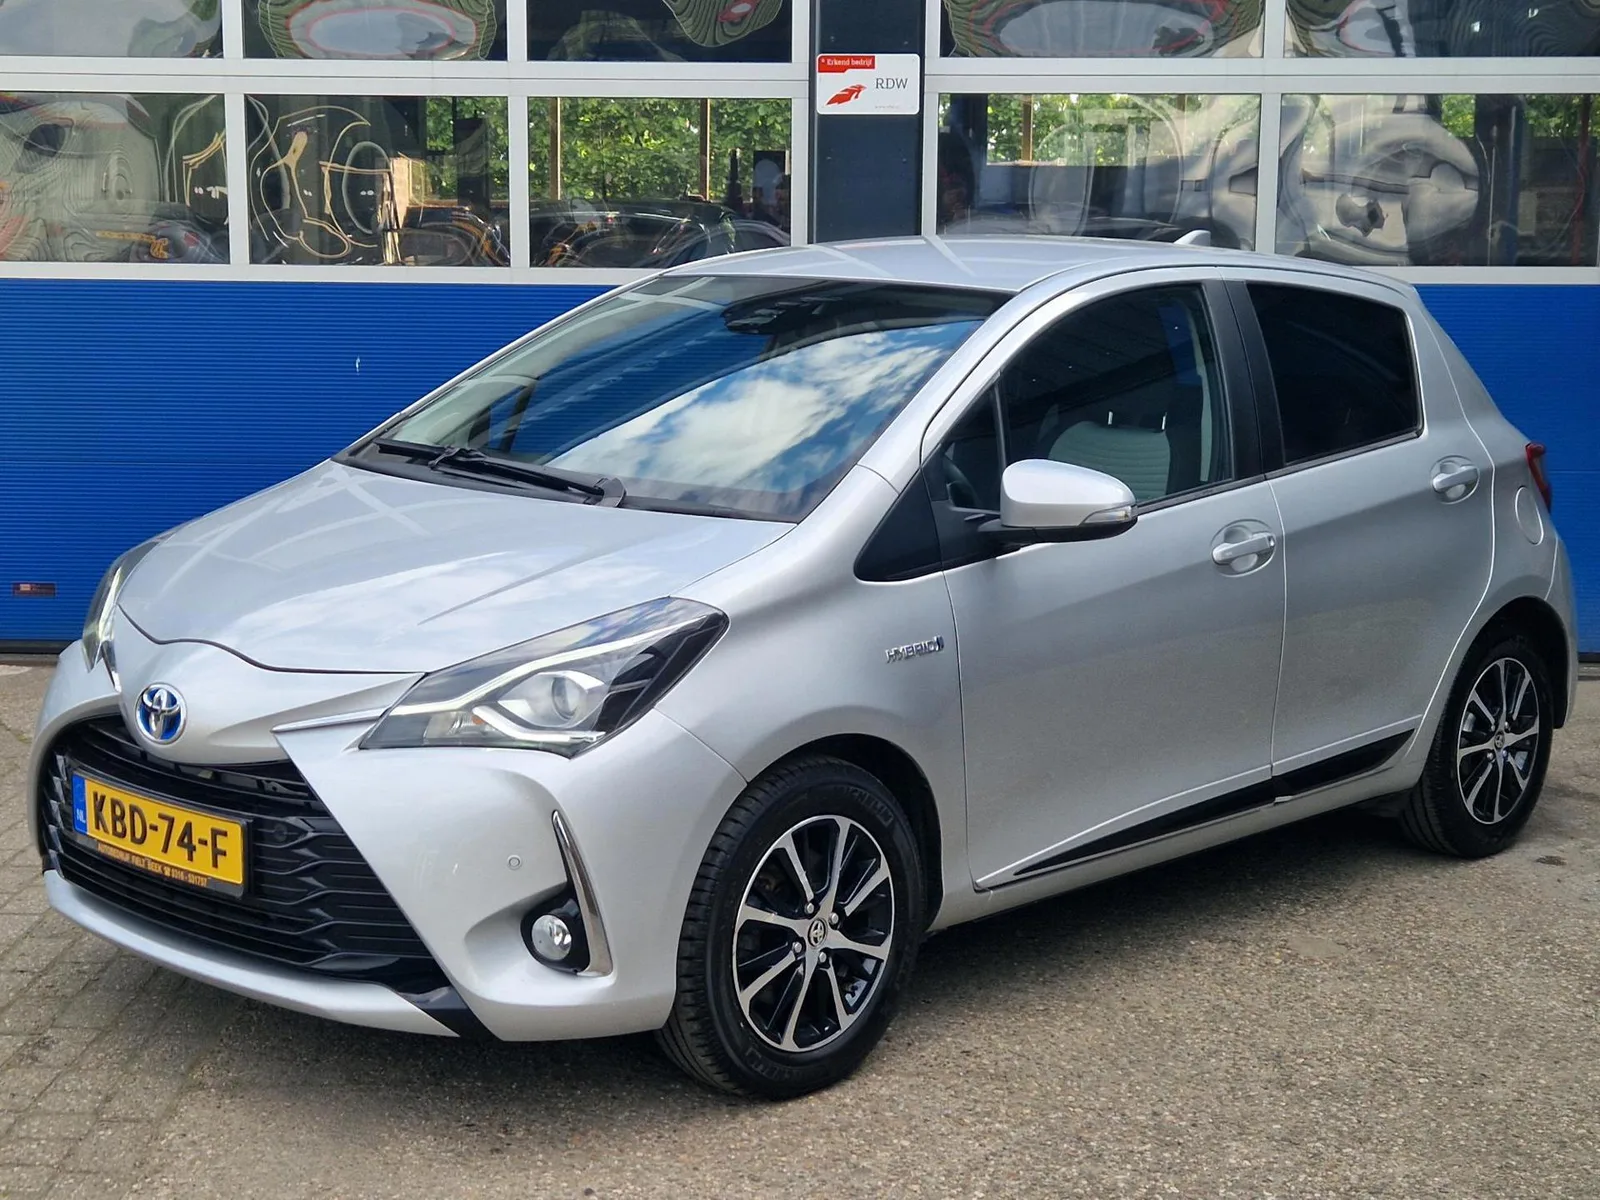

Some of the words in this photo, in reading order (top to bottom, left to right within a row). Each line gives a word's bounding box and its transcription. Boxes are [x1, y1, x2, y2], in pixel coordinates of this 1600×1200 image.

[826, 58, 849, 66] Erkend
[851, 58, 873, 67] bedrijf
[875, 77, 909, 90] RDW
[885, 640, 936, 664] HYBRID
[76, 808, 86, 824] NL
[93, 791, 228, 869] KBD-74-F
